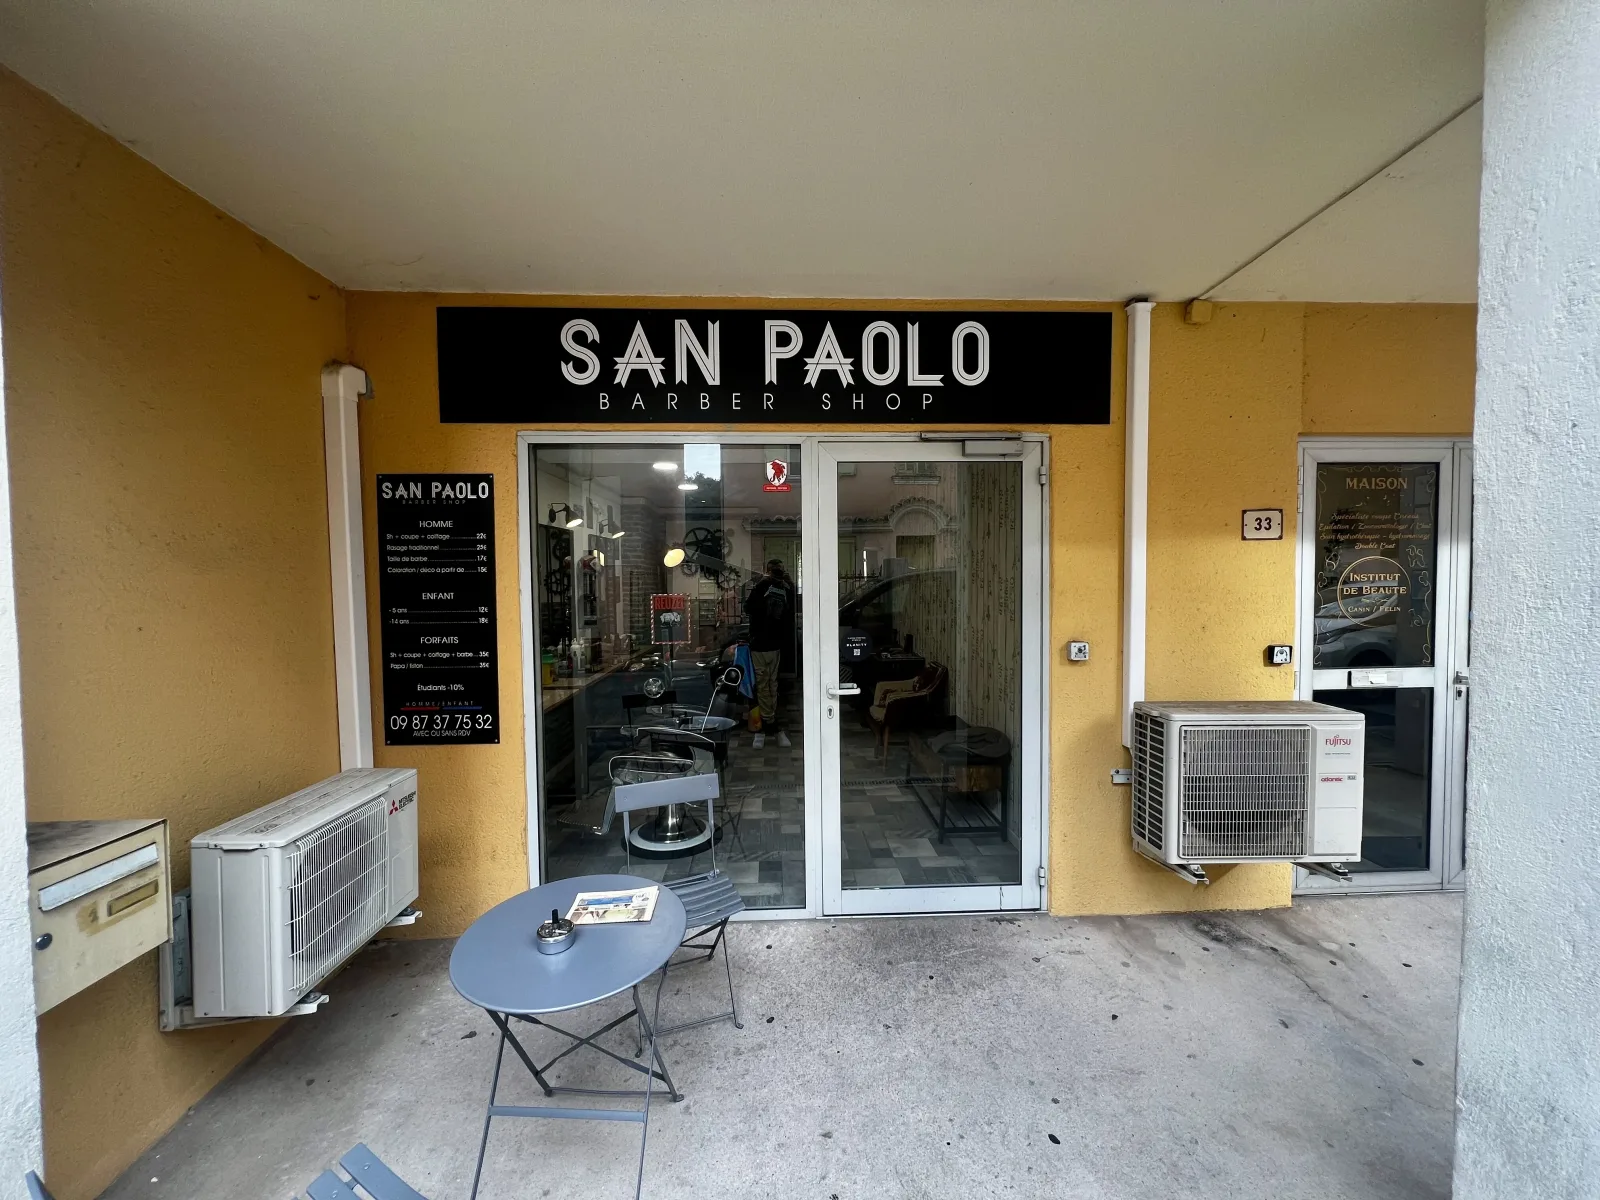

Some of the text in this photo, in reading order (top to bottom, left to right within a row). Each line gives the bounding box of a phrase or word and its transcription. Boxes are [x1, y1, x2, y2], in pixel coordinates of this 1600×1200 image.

[560, 319, 989, 389] SAN PAOLO
[600, 393, 933, 410] BARBER SHOP
[1346, 477, 1408, 490] MAISON
[382, 482, 489, 499] SAN PAOLO
[419, 520, 453, 528] HOMME
[1254, 517, 1272, 531] 33
[1350, 572, 1400, 582] INSTITUT
[422, 592, 454, 600] ENFANT
[420, 636, 459, 644] FORFAITS
[417, 683, 446, 691] Étudiants
[390, 714, 493, 730] 09 87 37 75 32
[458, 729, 472, 737] RDV
[1325, 735, 1351, 747] FUJITSU
